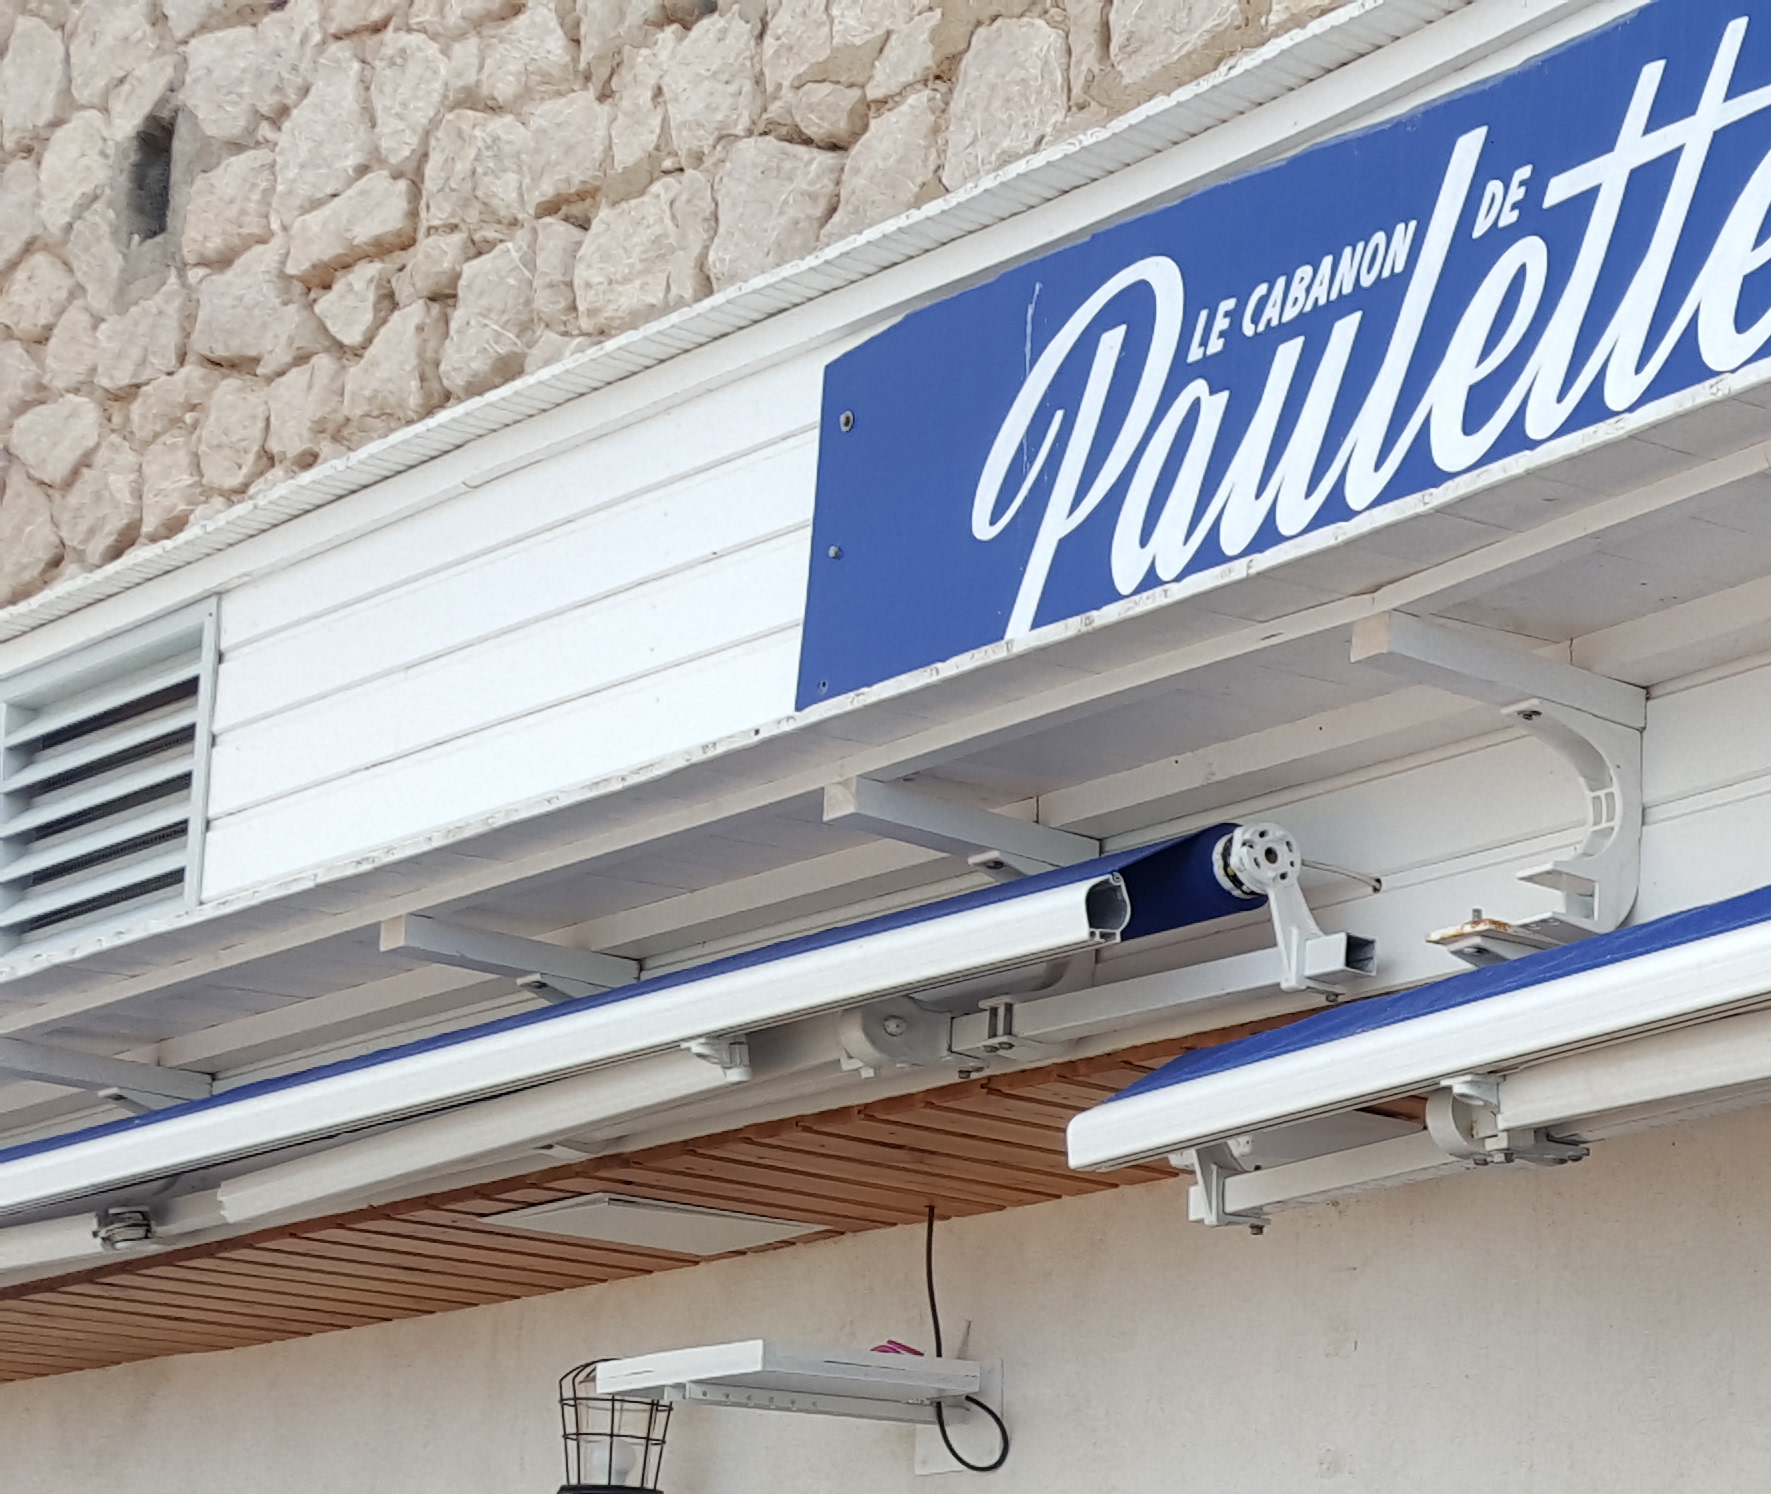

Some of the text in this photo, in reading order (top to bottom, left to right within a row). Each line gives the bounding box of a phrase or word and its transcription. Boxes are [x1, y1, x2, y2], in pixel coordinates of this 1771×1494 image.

[1184, 166, 1531, 364] LE CABANON DE
